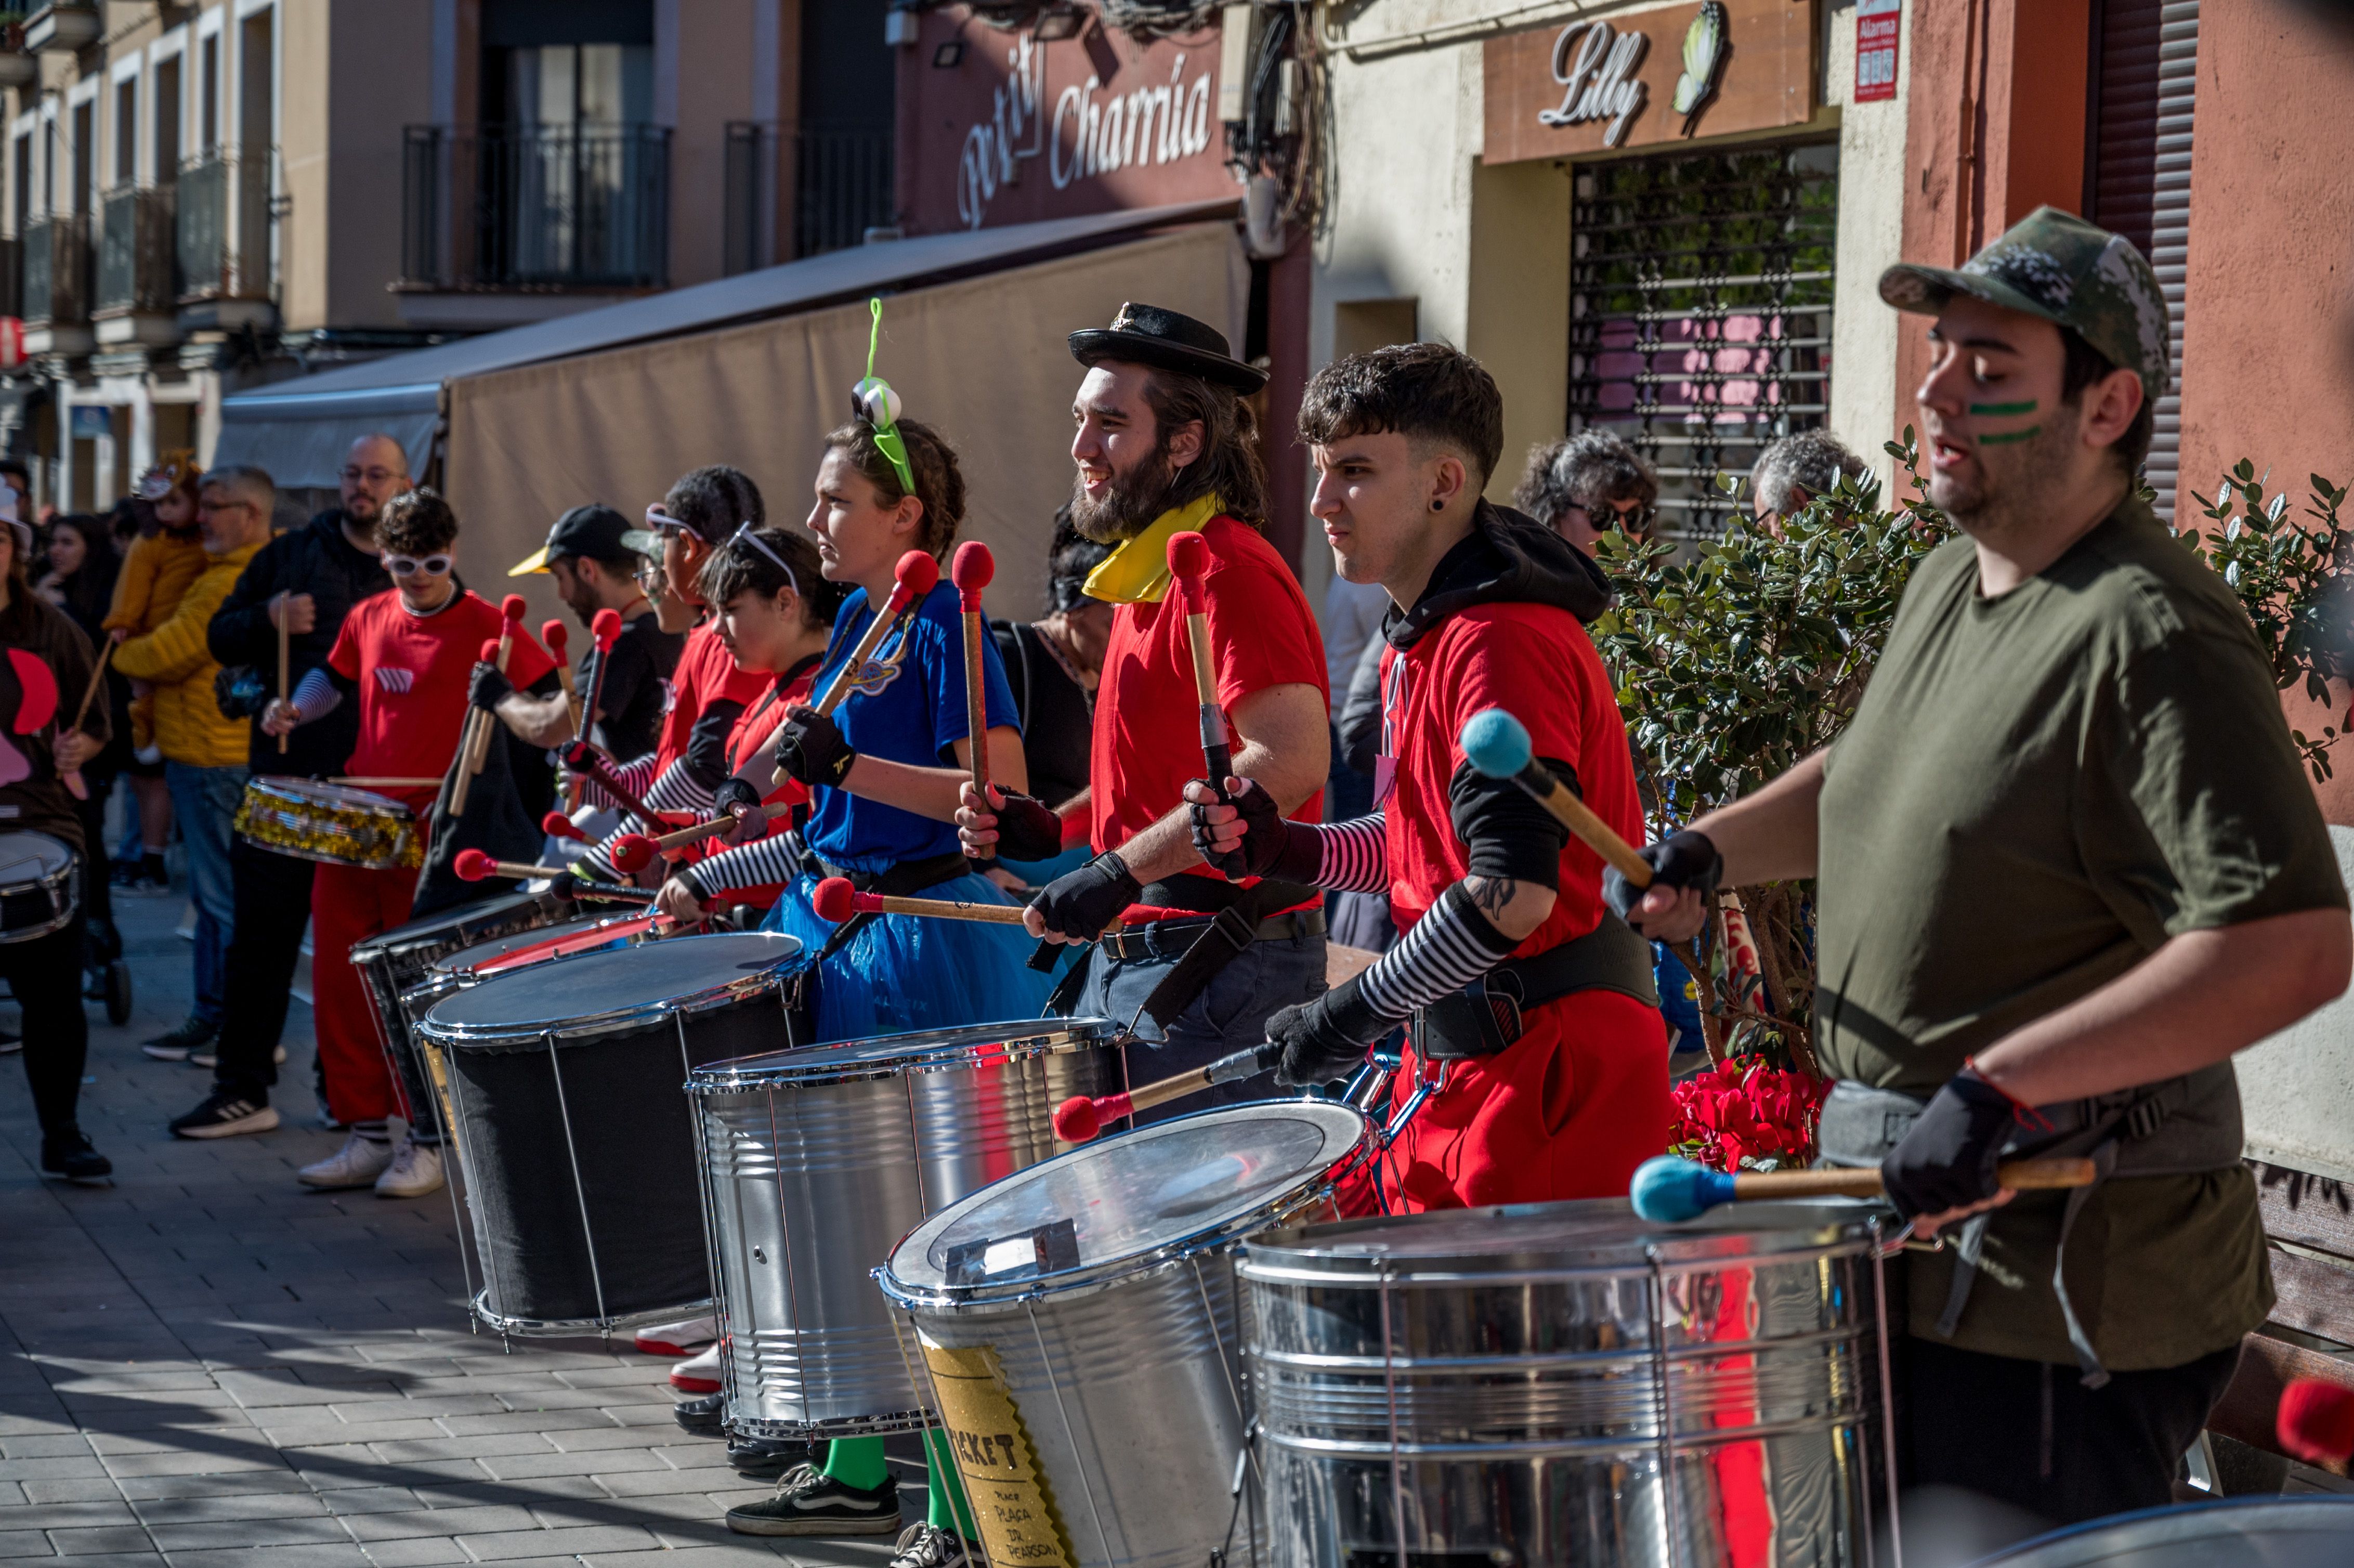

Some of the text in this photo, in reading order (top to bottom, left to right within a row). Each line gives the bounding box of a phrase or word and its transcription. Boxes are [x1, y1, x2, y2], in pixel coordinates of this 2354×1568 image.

[1859, 18, 1896, 38] Alarma
[1538, 20, 1641, 147] Lilly
[994, 1505, 1032, 1523] PLAÇA
[1006, 1528, 1024, 1543] DR
[1006, 1544, 1057, 1560] PEARSON
